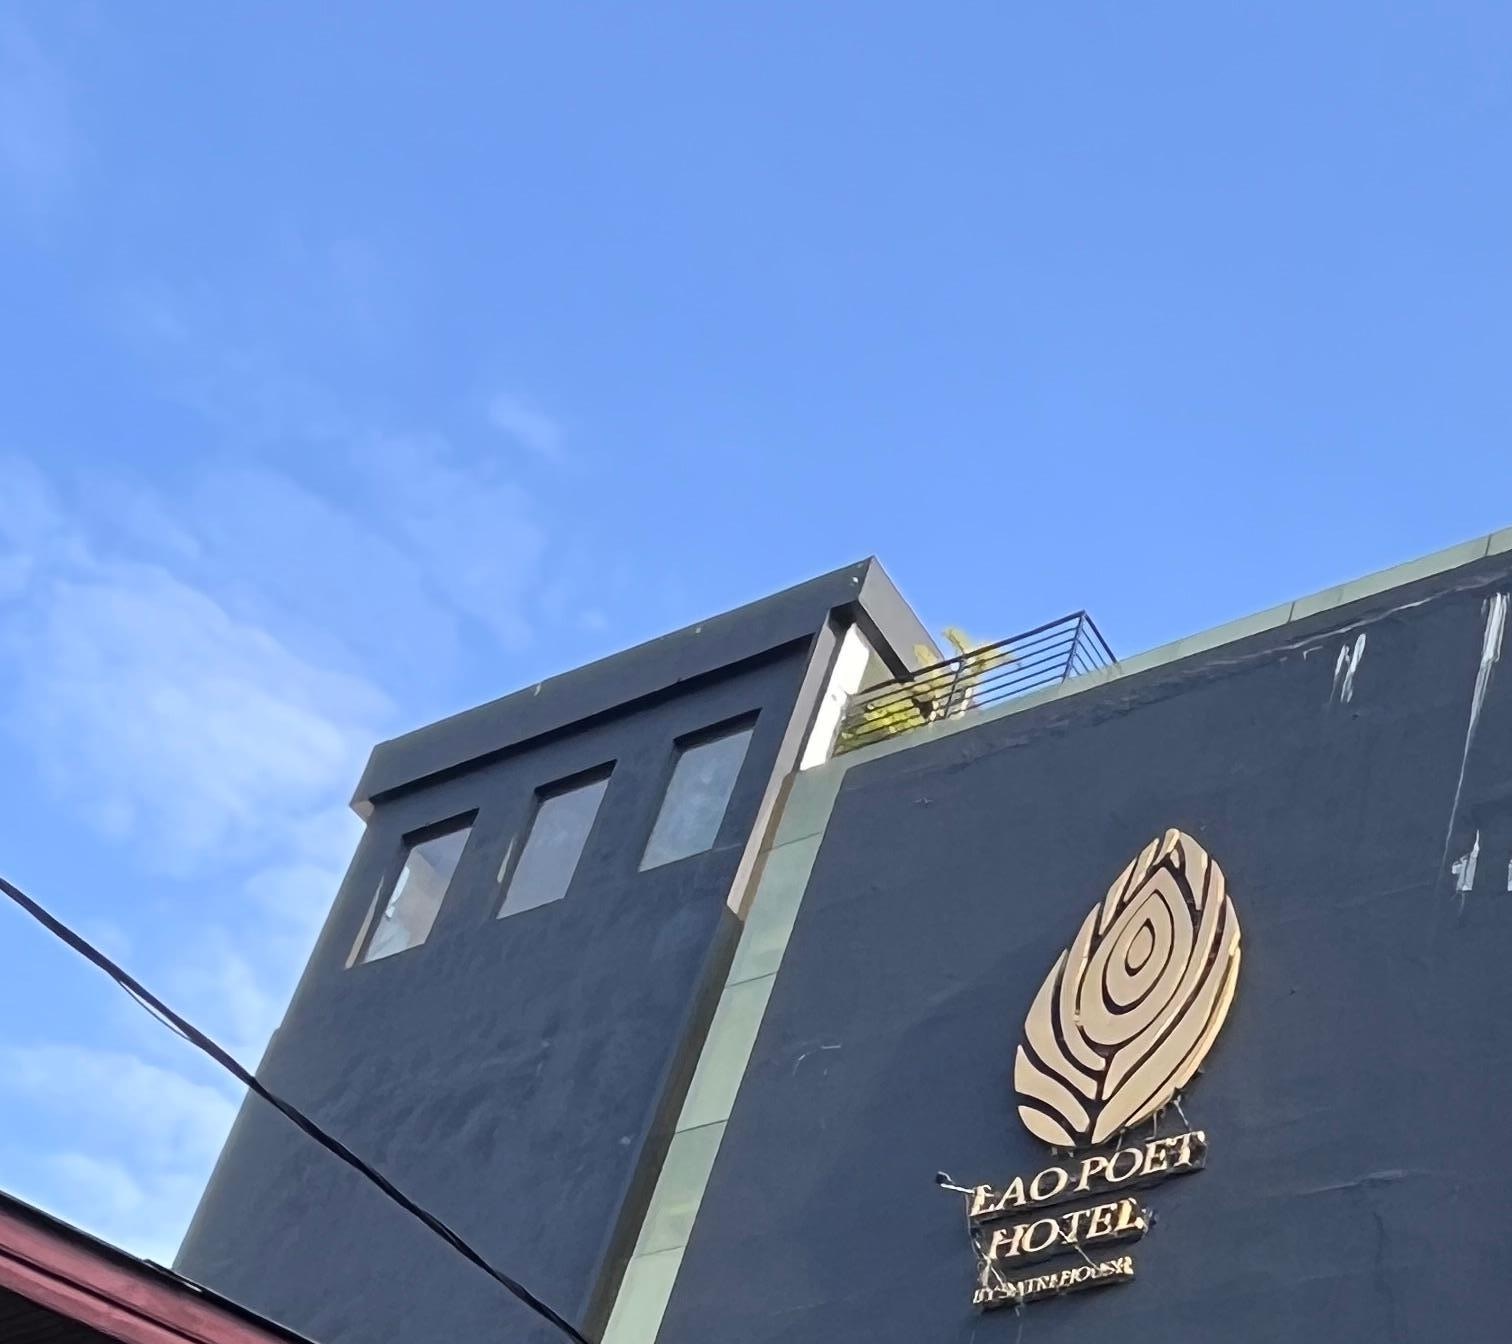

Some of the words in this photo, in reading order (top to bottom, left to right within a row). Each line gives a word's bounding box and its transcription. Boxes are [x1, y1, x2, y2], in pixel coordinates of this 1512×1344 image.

[969, 1166, 1069, 1217] LAO
[1073, 1130, 1206, 1192] POET
[989, 1197, 1145, 1260] HOTEL
